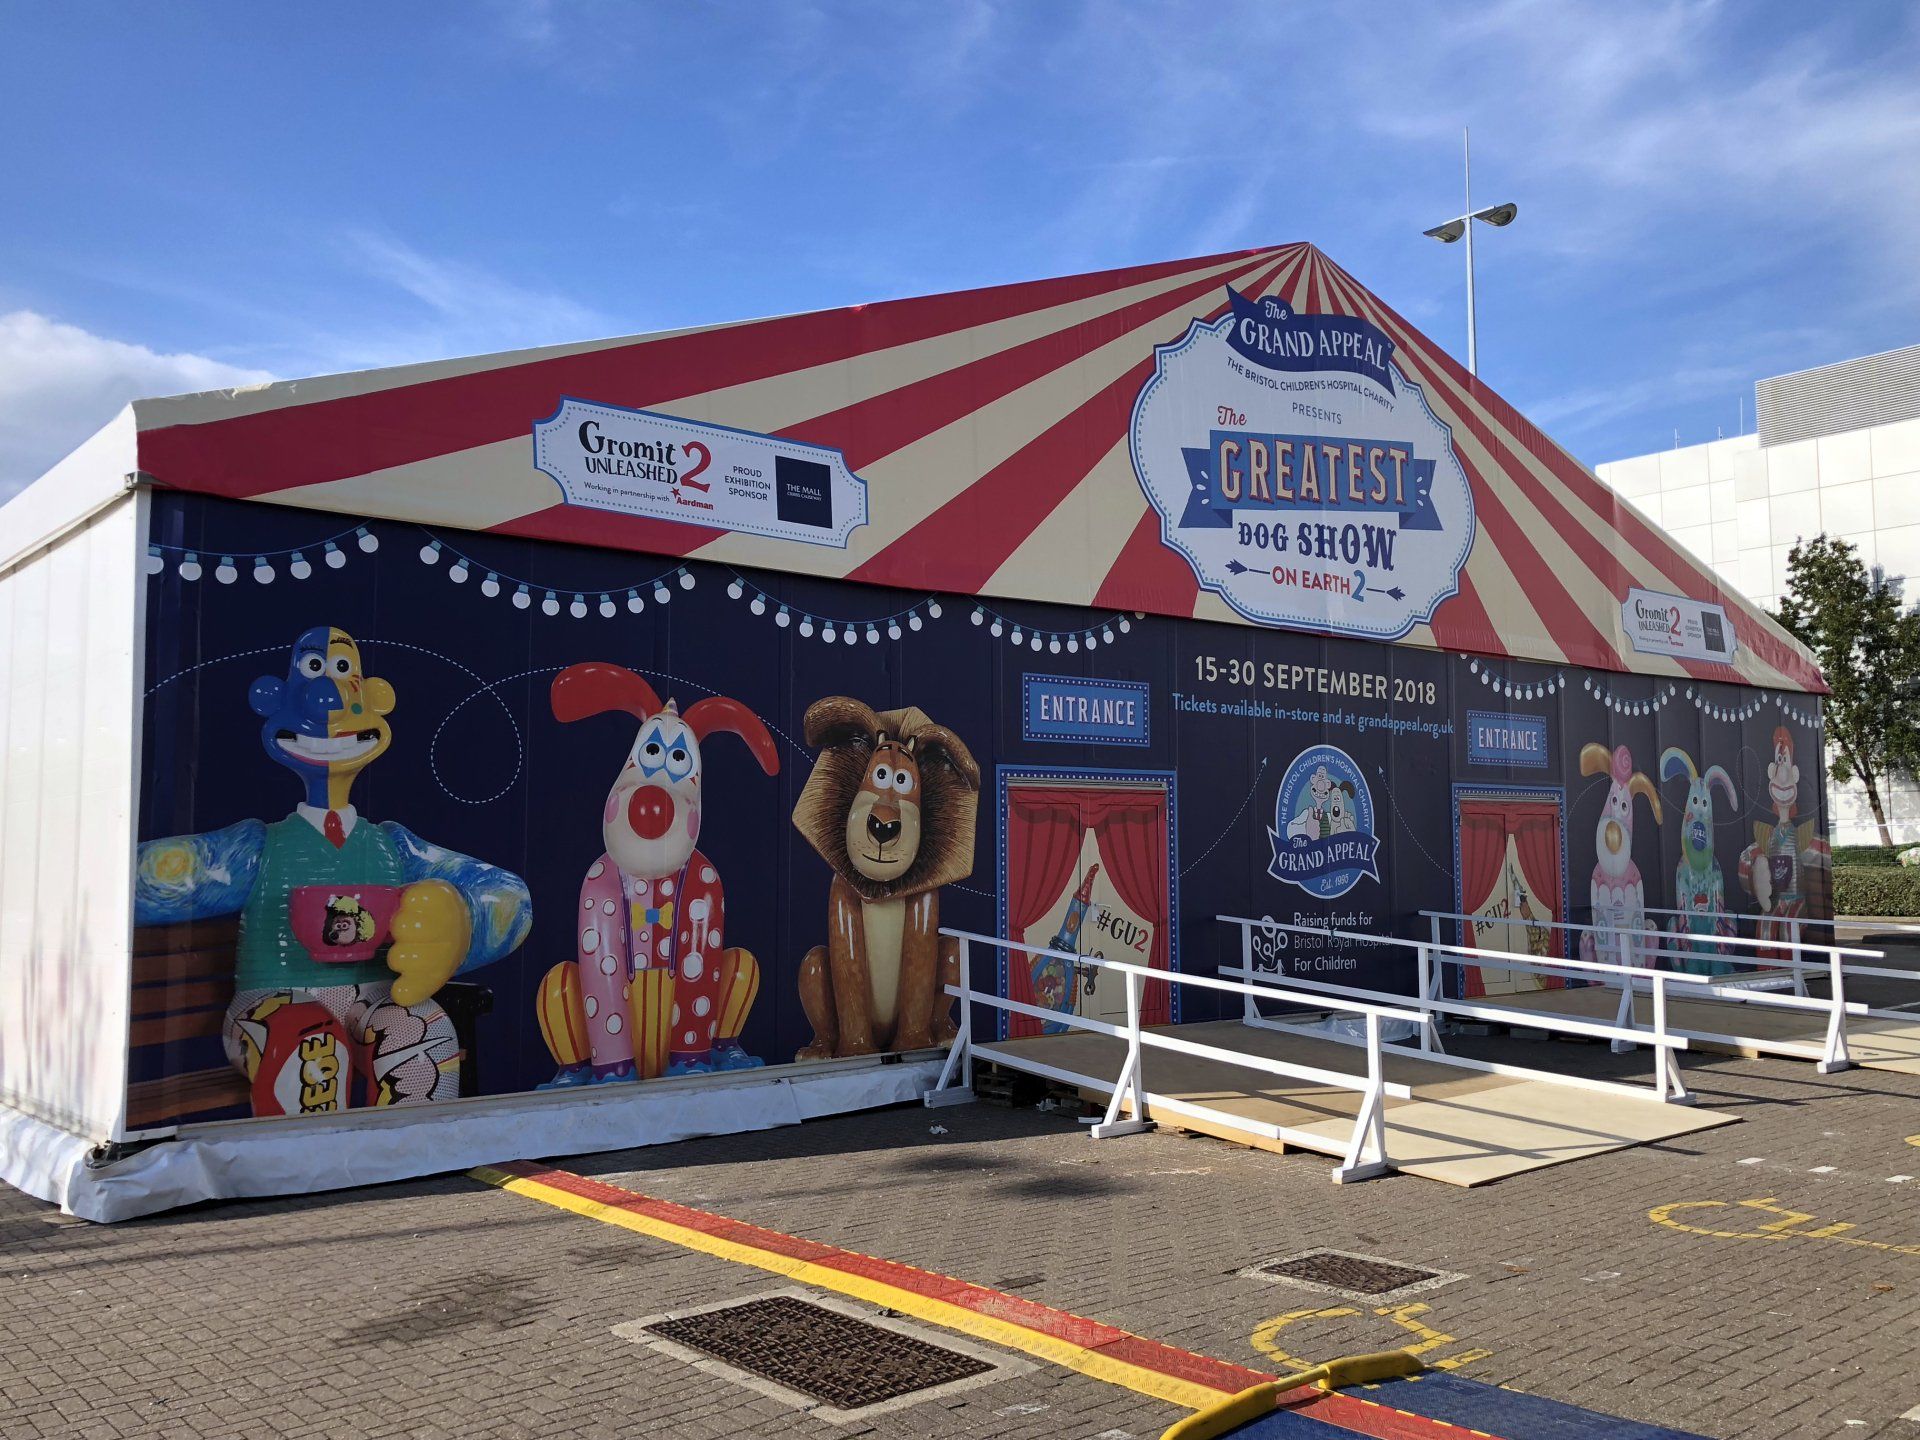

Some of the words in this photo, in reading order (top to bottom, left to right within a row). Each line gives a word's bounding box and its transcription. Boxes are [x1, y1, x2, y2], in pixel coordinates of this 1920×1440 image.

[1264, 300, 1287, 321] The
[1240, 318, 1314, 358] GRAND
[1320, 330, 1386, 371] APPEAL
[1227, 356, 1243, 376] THE
[1245, 368, 1279, 390] BRISTOL
[1280, 380, 1326, 392] CHILDREN'S
[1327, 380, 1363, 394] HOSPITAL
[1364, 388, 1394, 412] CHARITY
[1217, 406, 1248, 426] The
[1292, 402, 1342, 424] PRESENTS
[578, 420, 677, 466] Gromit
[584, 456, 679, 486] UNLEASHED
[680, 441, 712, 493] 2
[733, 466, 762, 478] PROUD
[1218, 440, 1410, 505] GREATEST
[584, 482, 612, 494] Working
[620, 490, 656, 500] partnership
[724, 476, 771, 490] EXHIBITION
[728, 488, 768, 501] SPONSOR
[786, 484, 800, 492] THE
[802, 486, 822, 496] MALL
[676, 496, 714, 510] Aardman
[1238, 521, 1290, 552] DOG
[1296, 522, 1398, 572] SHOW
[1272, 565, 1298, 586] ON
[1302, 570, 1351, 596] EARTH
[1351, 569, 1366, 602] 2
[1636, 598, 1669, 622] Gromit
[1670, 606, 1682, 636] 2
[1638, 620, 1670, 634] UNLEASHED
[1195, 656, 1256, 686] 15-30
[1263, 662, 1388, 700] SEPTEMBER
[1394, 678, 1436, 706] 2018
[1041, 694, 1136, 726] ENTRANCE
[1172, 692, 1218, 714] Tickets
[1220, 700, 1272, 718] available
[1274, 702, 1320, 722] in-store
[1322, 708, 1342, 724] and
[1344, 712, 1356, 726] at
[1358, 713, 1454, 739] grandappeal.org.uk
[1478, 727, 1538, 752] ENTRANCE
[1298, 754, 1334, 772] CHILDREN'S
[1335, 758, 1360, 790] HOSPITAL
[1283, 770, 1300, 804] BRISTOL
[1280, 806, 1288, 824] THE
[1358, 788, 1370, 829] CHARITY
[1292, 837, 1308, 848] The
[1278, 850, 1324, 872] GRAND
[1327, 842, 1370, 863] APPEAL
[1320, 878, 1334, 892] Est.
[1096, 910, 1148, 953] #GU2
[1294, 912, 1329, 930] Raising
[1330, 912, 1356, 926] funds
[1359, 912, 1373, 926] for
[1294, 934, 1324, 949] Bristol
[1328, 934, 1352, 952] Royal
[1294, 957, 1312, 972] For
[1314, 956, 1356, 970] Children
